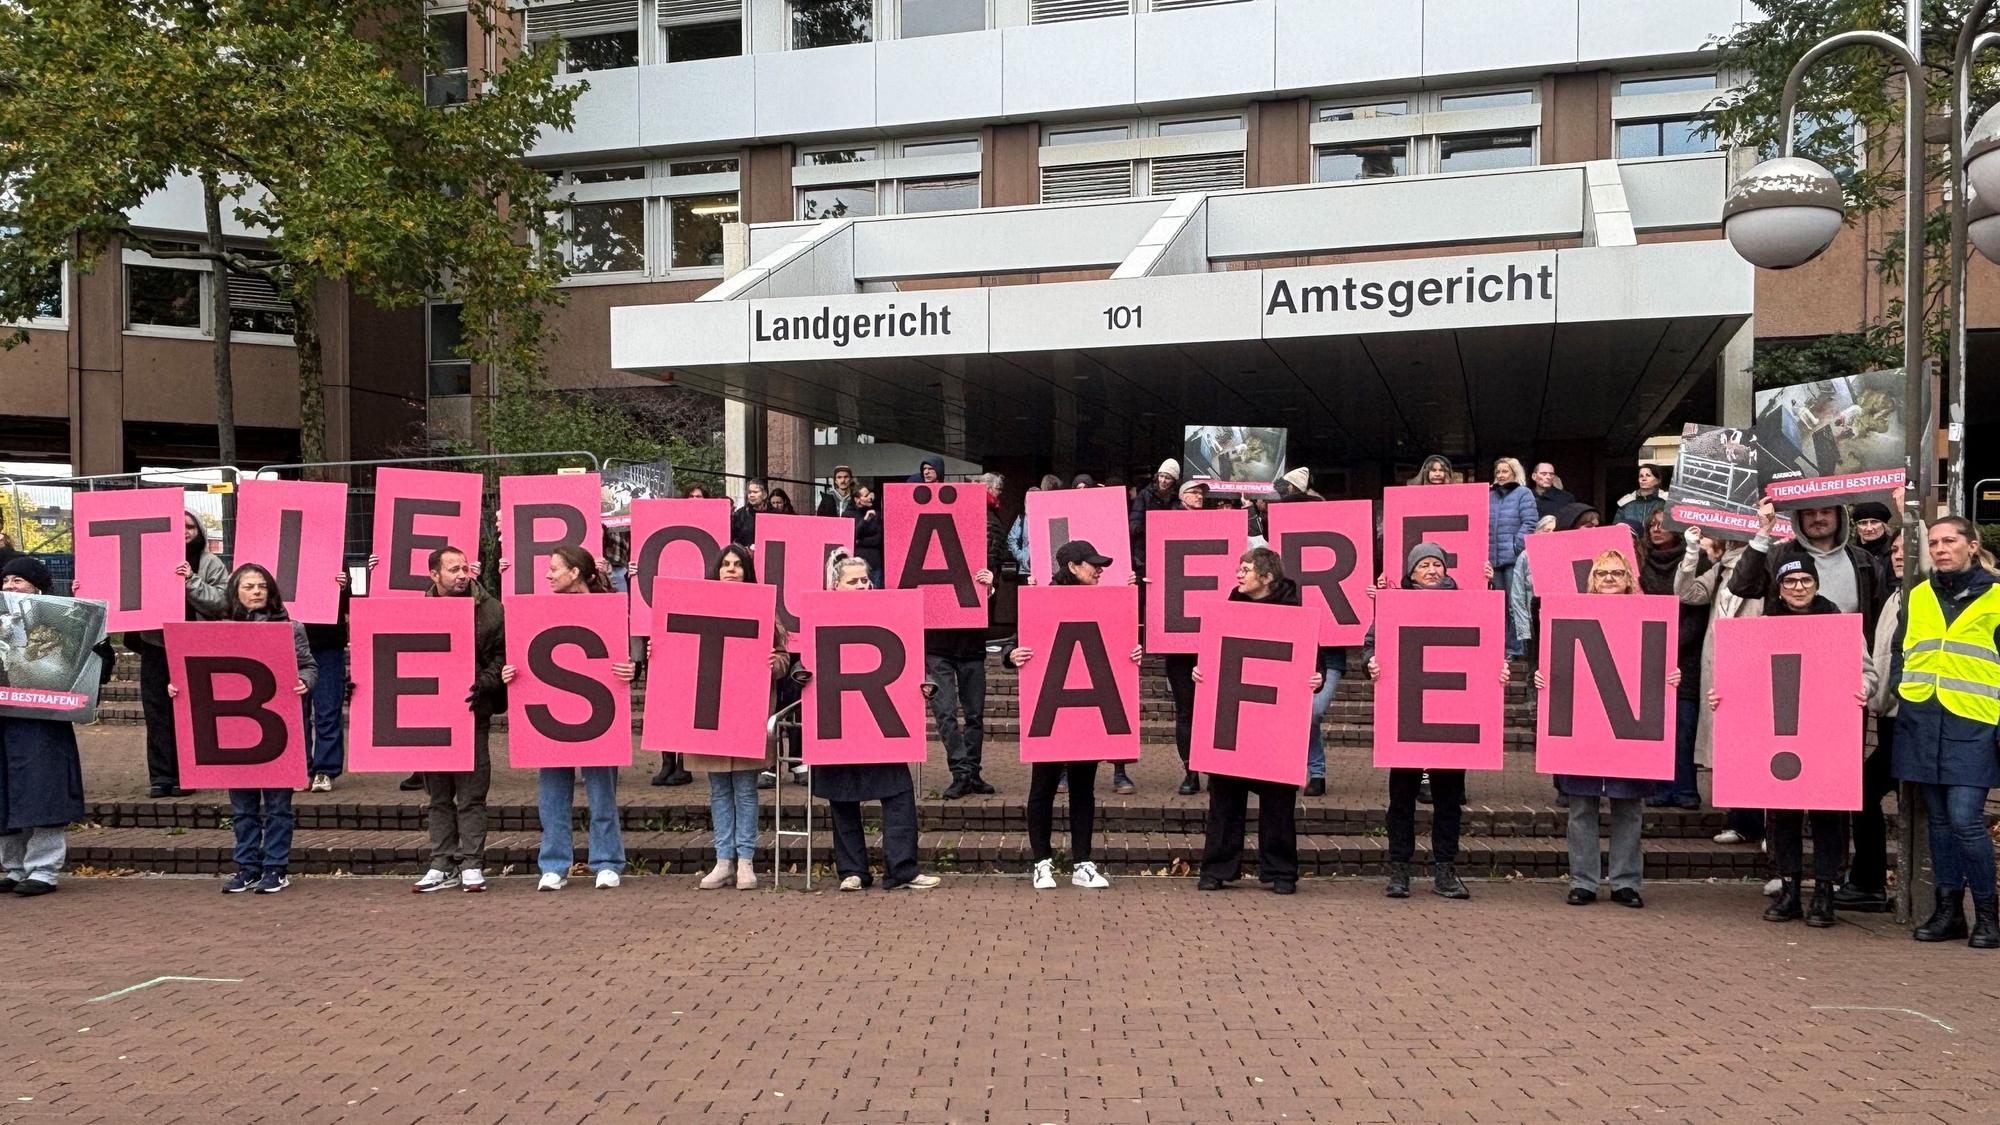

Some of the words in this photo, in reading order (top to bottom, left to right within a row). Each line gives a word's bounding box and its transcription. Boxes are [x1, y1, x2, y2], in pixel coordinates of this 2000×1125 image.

[1266, 264, 1553, 318] Amtsgericht
[755, 302, 951, 347] Landgericht
[1103, 306, 1142, 330] 101
[1772, 479, 1844, 497] TIERQUÄLEREI
[1679, 509, 1747, 528] TIERQUÄLEREI
[11, 691, 79, 706] BESTRAFEN!
